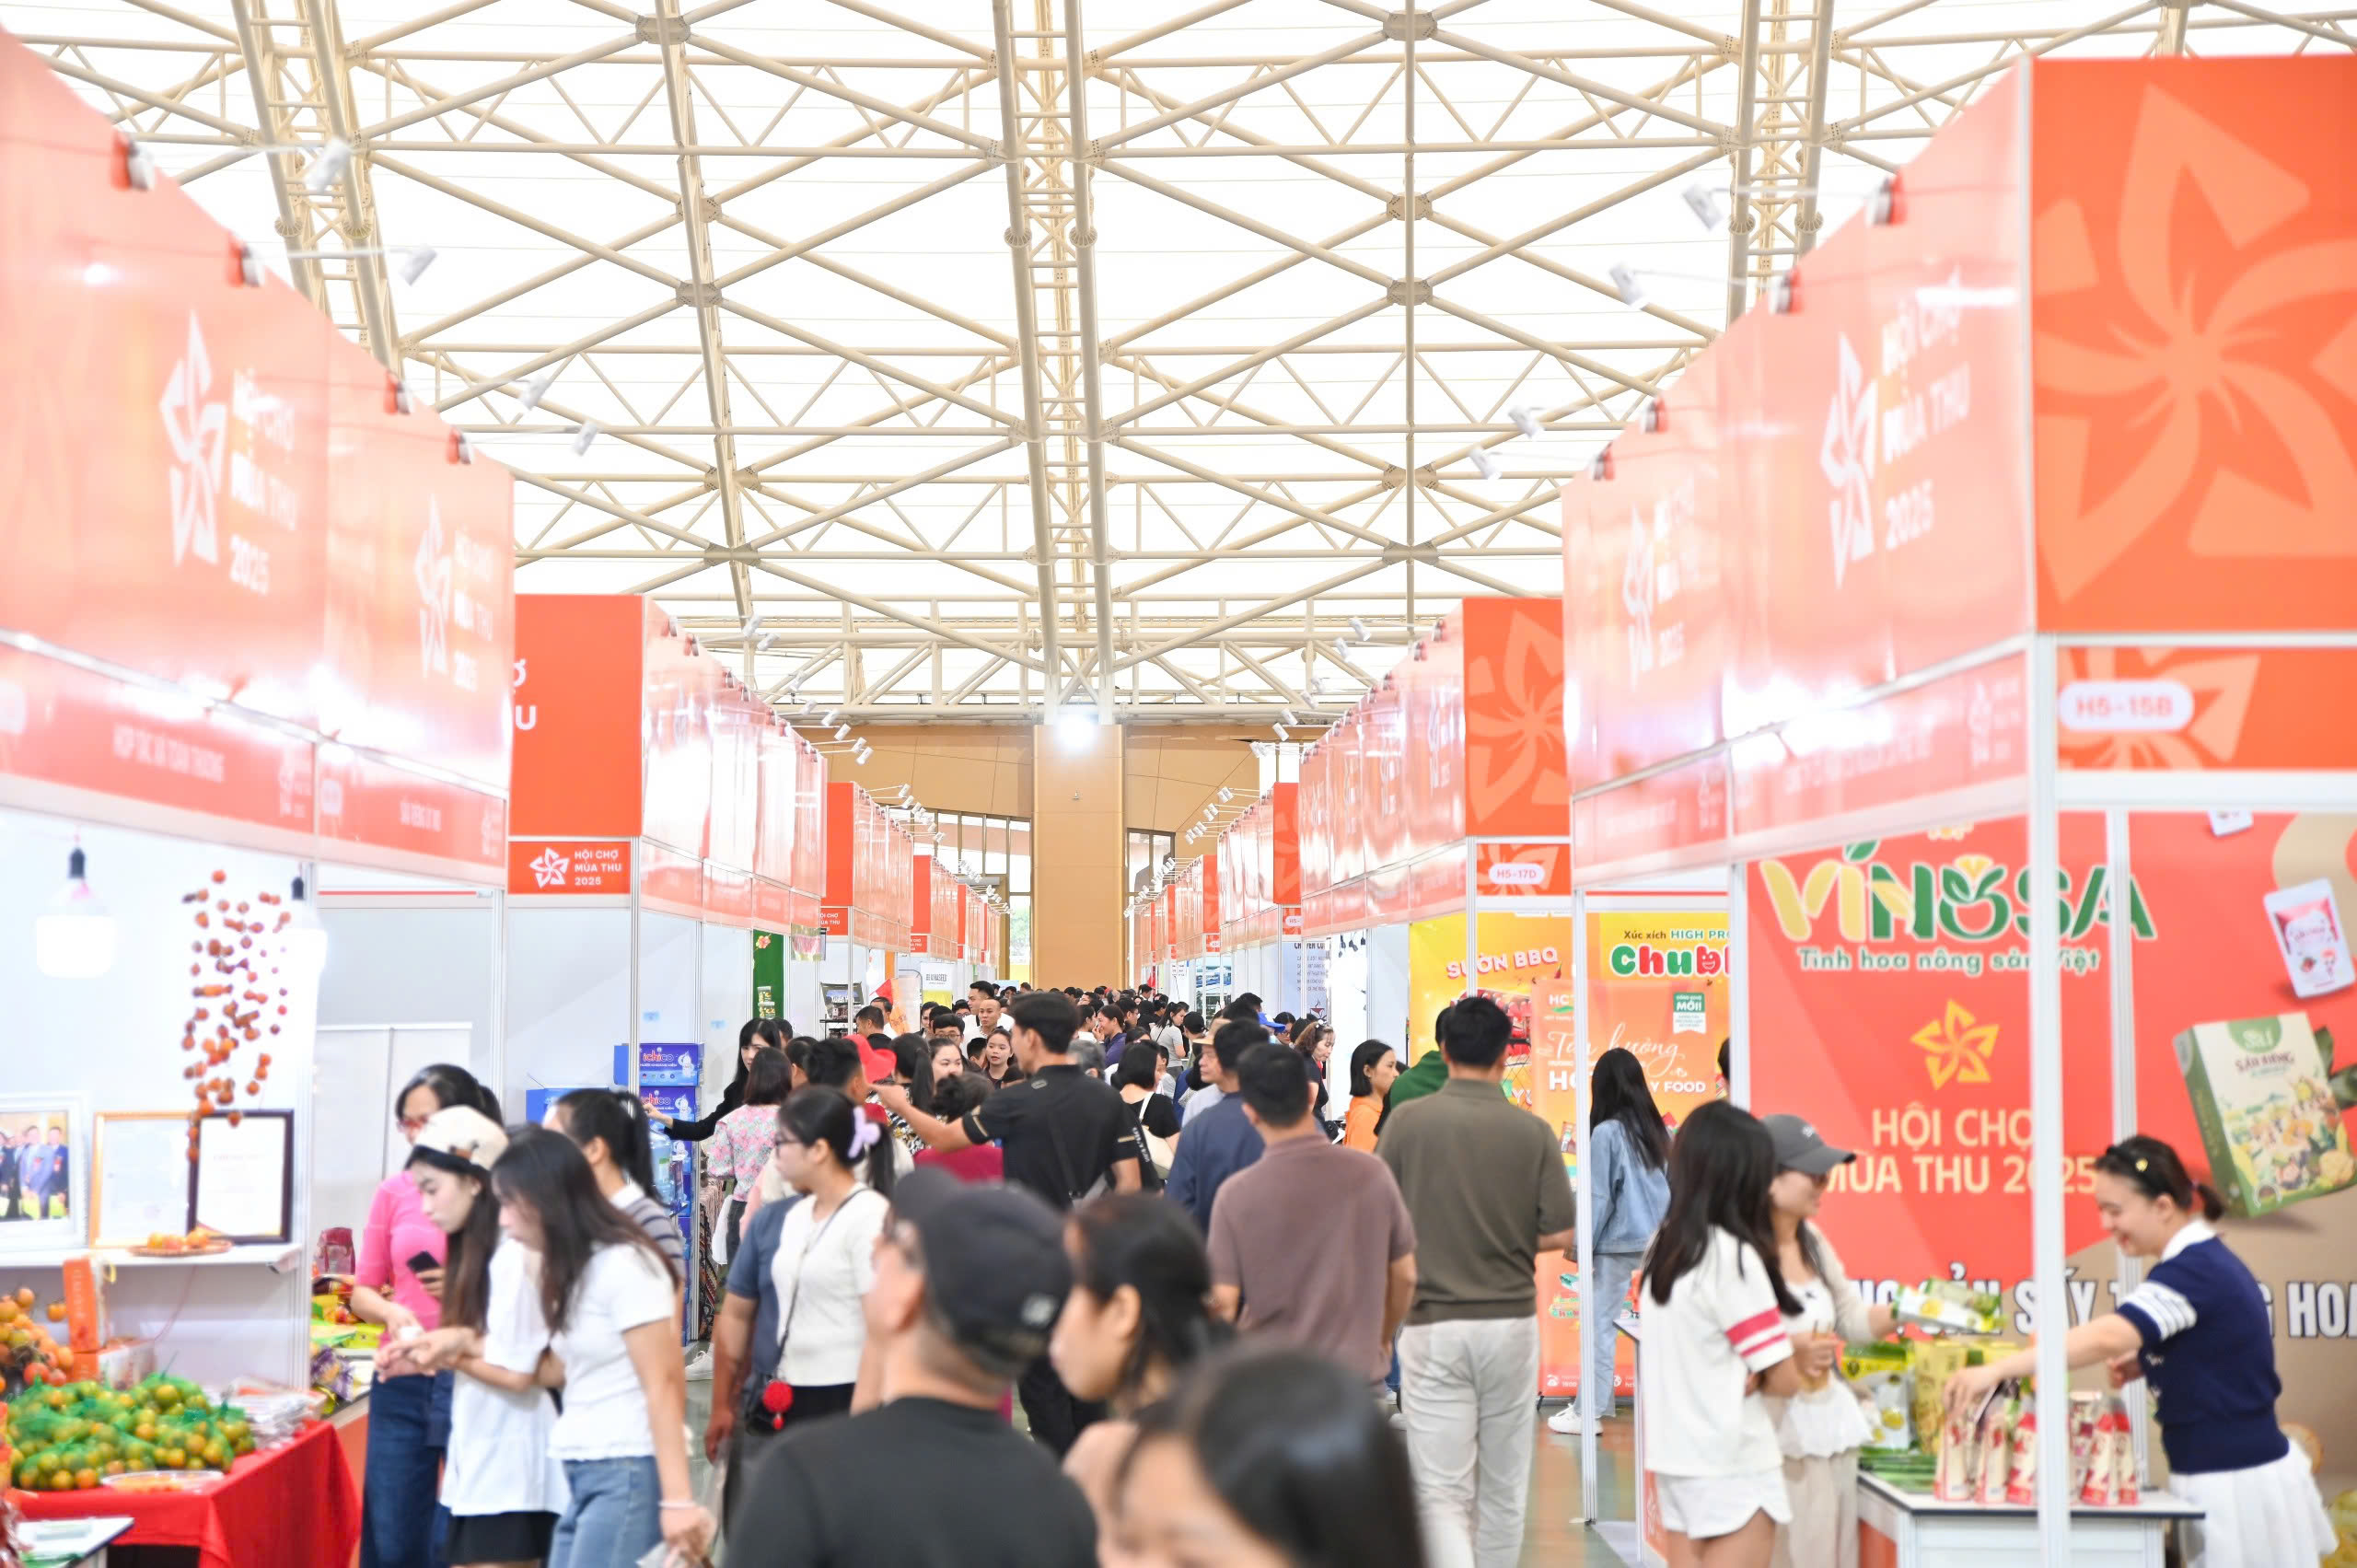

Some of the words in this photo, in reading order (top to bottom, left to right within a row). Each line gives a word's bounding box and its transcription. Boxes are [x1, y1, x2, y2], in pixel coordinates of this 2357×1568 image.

[1885, 479, 1933, 551] 2025
[230, 532, 270, 596] 2025
[575, 849, 593, 861] HỘI
[595, 849, 620, 863] CHỢ
[575, 862, 598, 873] MÙA
[601, 863, 621, 872] THU
[1496, 869, 1537, 878] H5-17D
[575, 877, 601, 886] 2025
[1624, 930, 1643, 940] Xúc
[1646, 930, 1666, 940] xích
[1670, 930, 1703, 939] HIGH
[1513, 947, 1559, 969] BBQ
[1860, 947, 1909, 970] hoa
[1918, 947, 1981, 976] nông
[644, 1050, 674, 1062] ichico
[1665, 1081, 1706, 1093] FOOD
[1872, 1101, 1942, 1151] HỘI
[1912, 1156, 1990, 1194] THU
